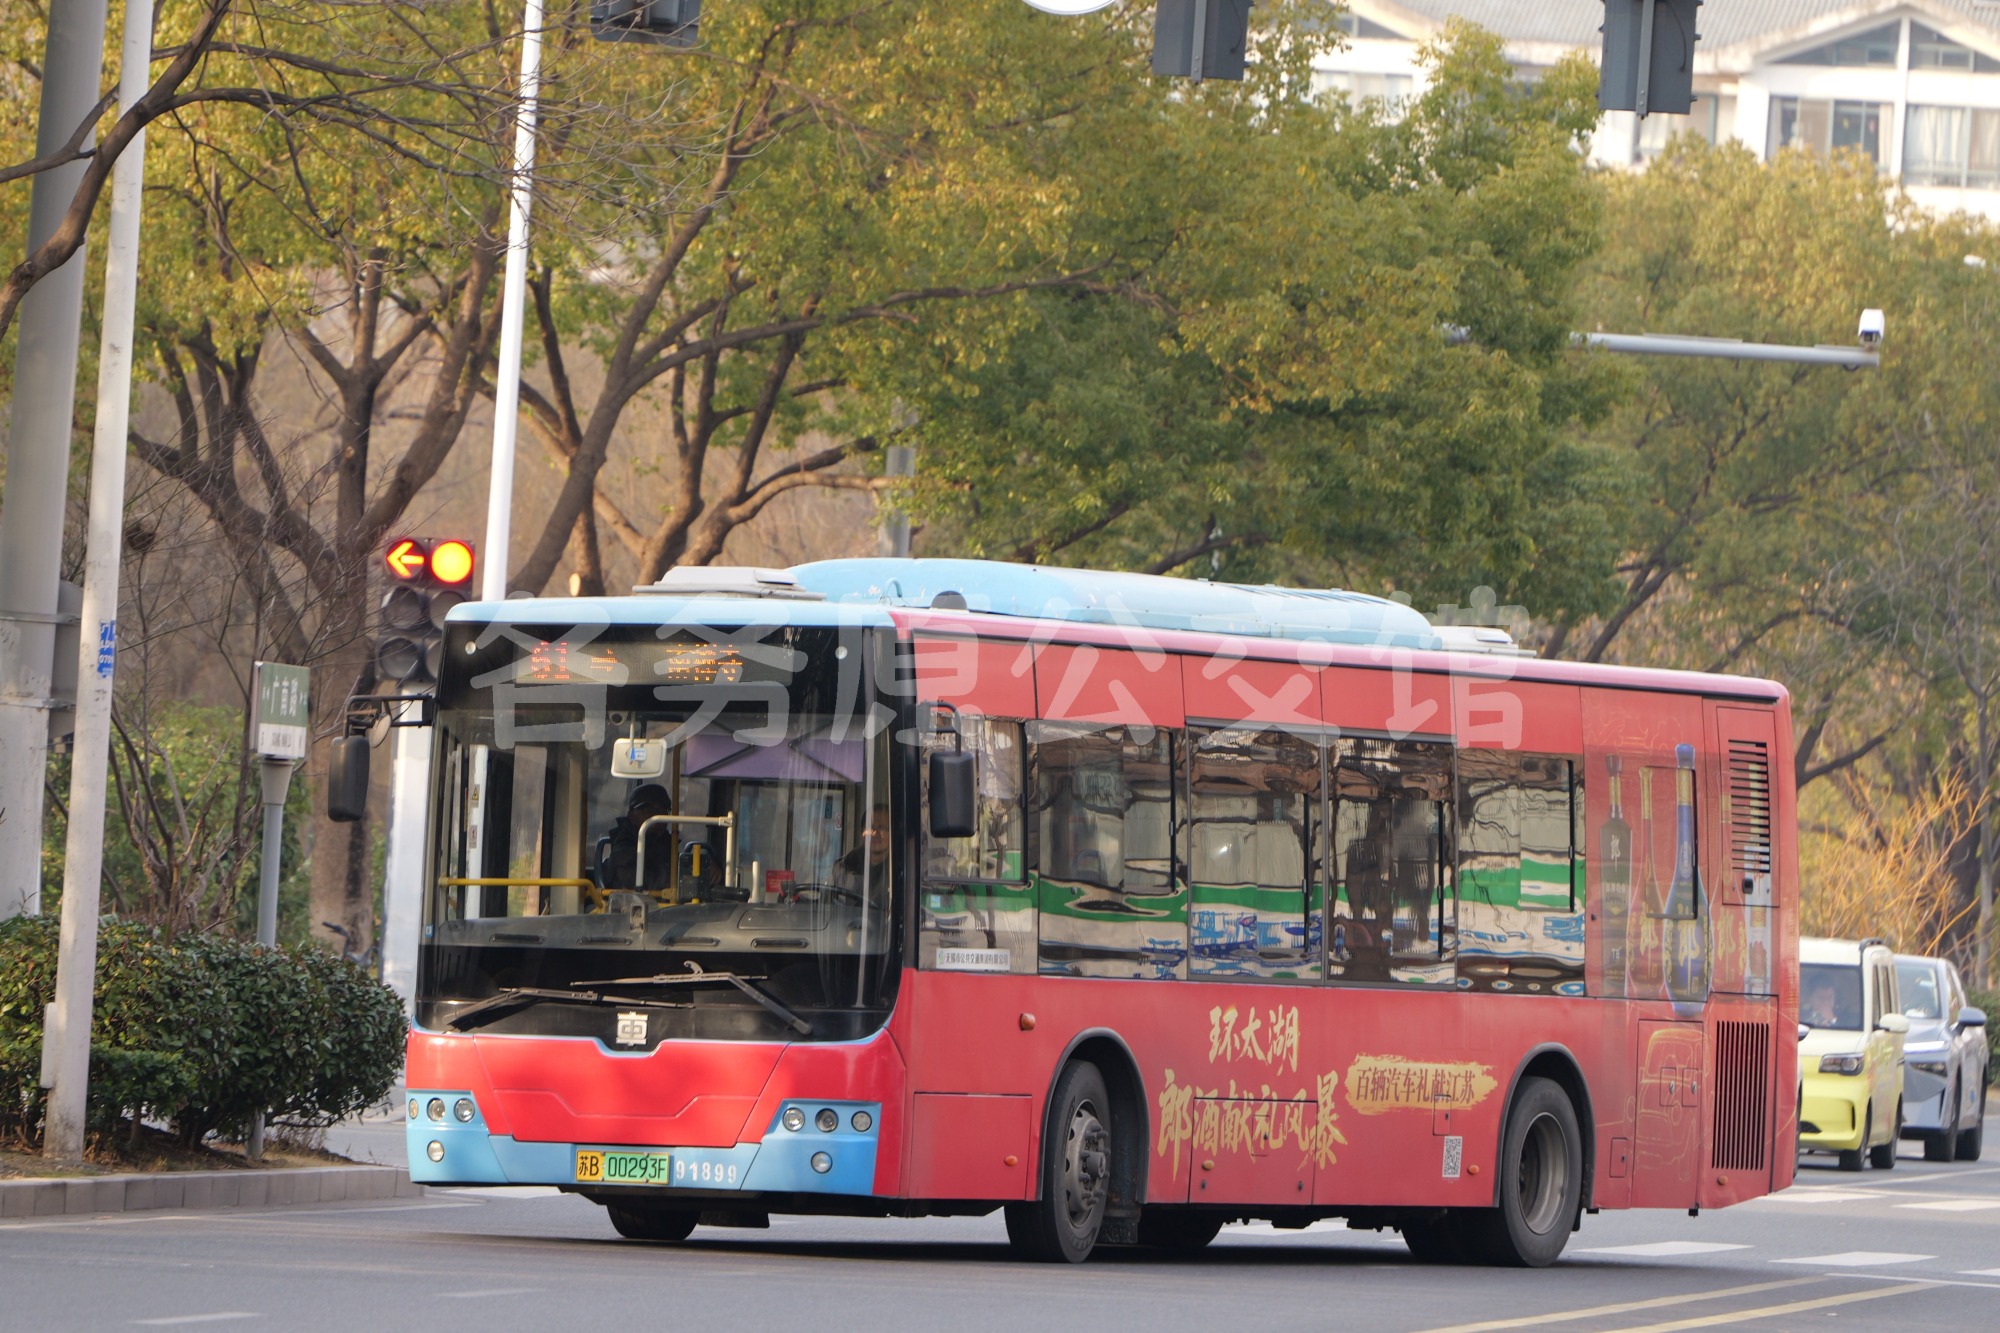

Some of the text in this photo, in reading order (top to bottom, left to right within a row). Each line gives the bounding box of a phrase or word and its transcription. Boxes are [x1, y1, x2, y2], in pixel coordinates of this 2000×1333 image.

[1208, 1004, 1301, 1076] 环太湖
[1355, 1066, 1476, 1105] 百辆汽车礼献江苏
[1156, 1068, 1348, 1184] 郎酒献礼风暴
[675, 1159, 737, 1184] 91899
